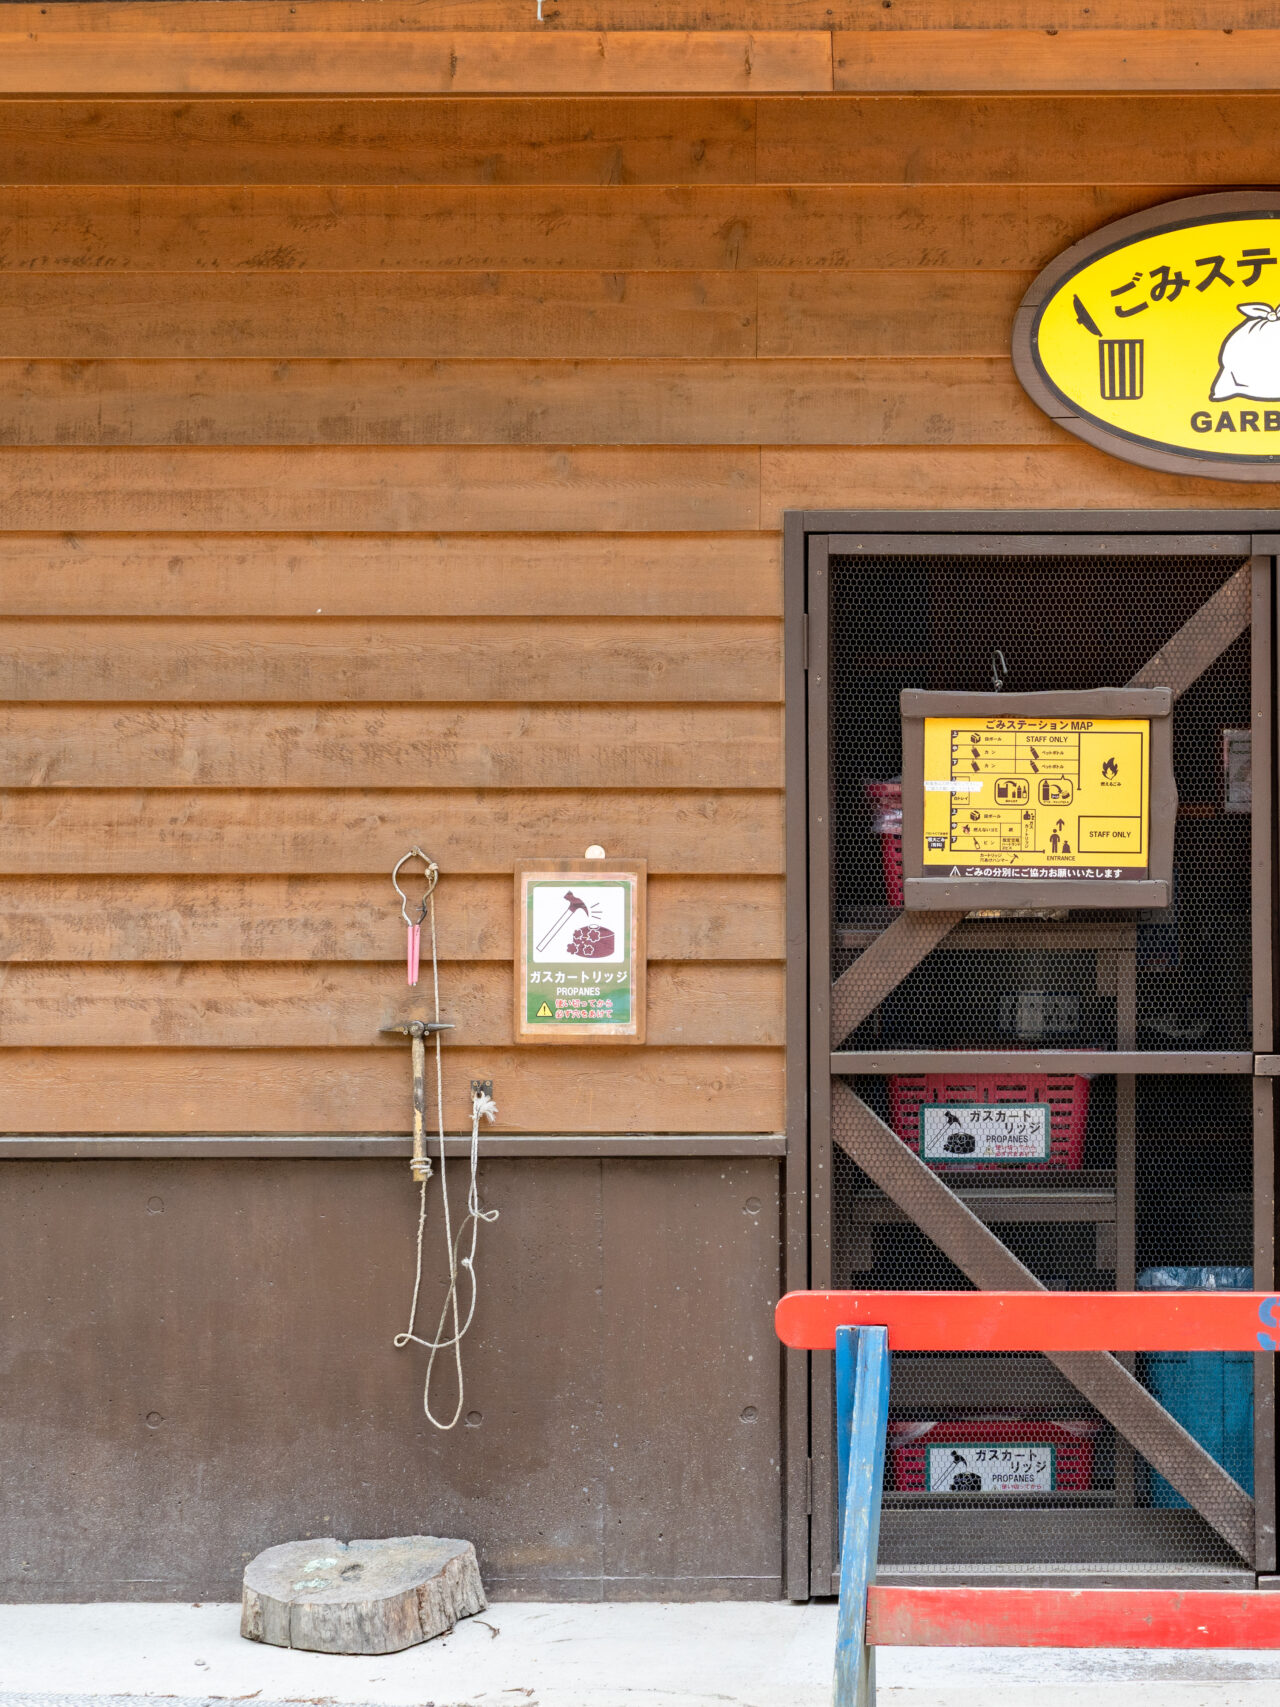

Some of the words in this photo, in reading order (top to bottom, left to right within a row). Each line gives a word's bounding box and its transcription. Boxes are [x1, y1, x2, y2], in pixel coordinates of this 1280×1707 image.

[986, 719, 1069, 730] ごみステーション
[1071, 721, 1093, 731] MAP
[965, 867, 1123, 878] ごみの分別にご協力お願いいたします
[530, 970, 628, 984] ガスカートリッジ
[556, 987, 601, 996] PROPANES
[555, 999, 613, 1008] 使い切ってから
[555, 1009, 613, 1018] 必ず穴をあけて
[970, 1110, 1031, 1122] ガスカート
[1004, 1122, 1041, 1134] リッジ
[986, 1135, 1029, 1143] PROPANES
[975, 1449, 1037, 1462] ガスカート
[1010, 1461, 1047, 1474] リッジ
[992, 1474, 1034, 1483] PROPANES
